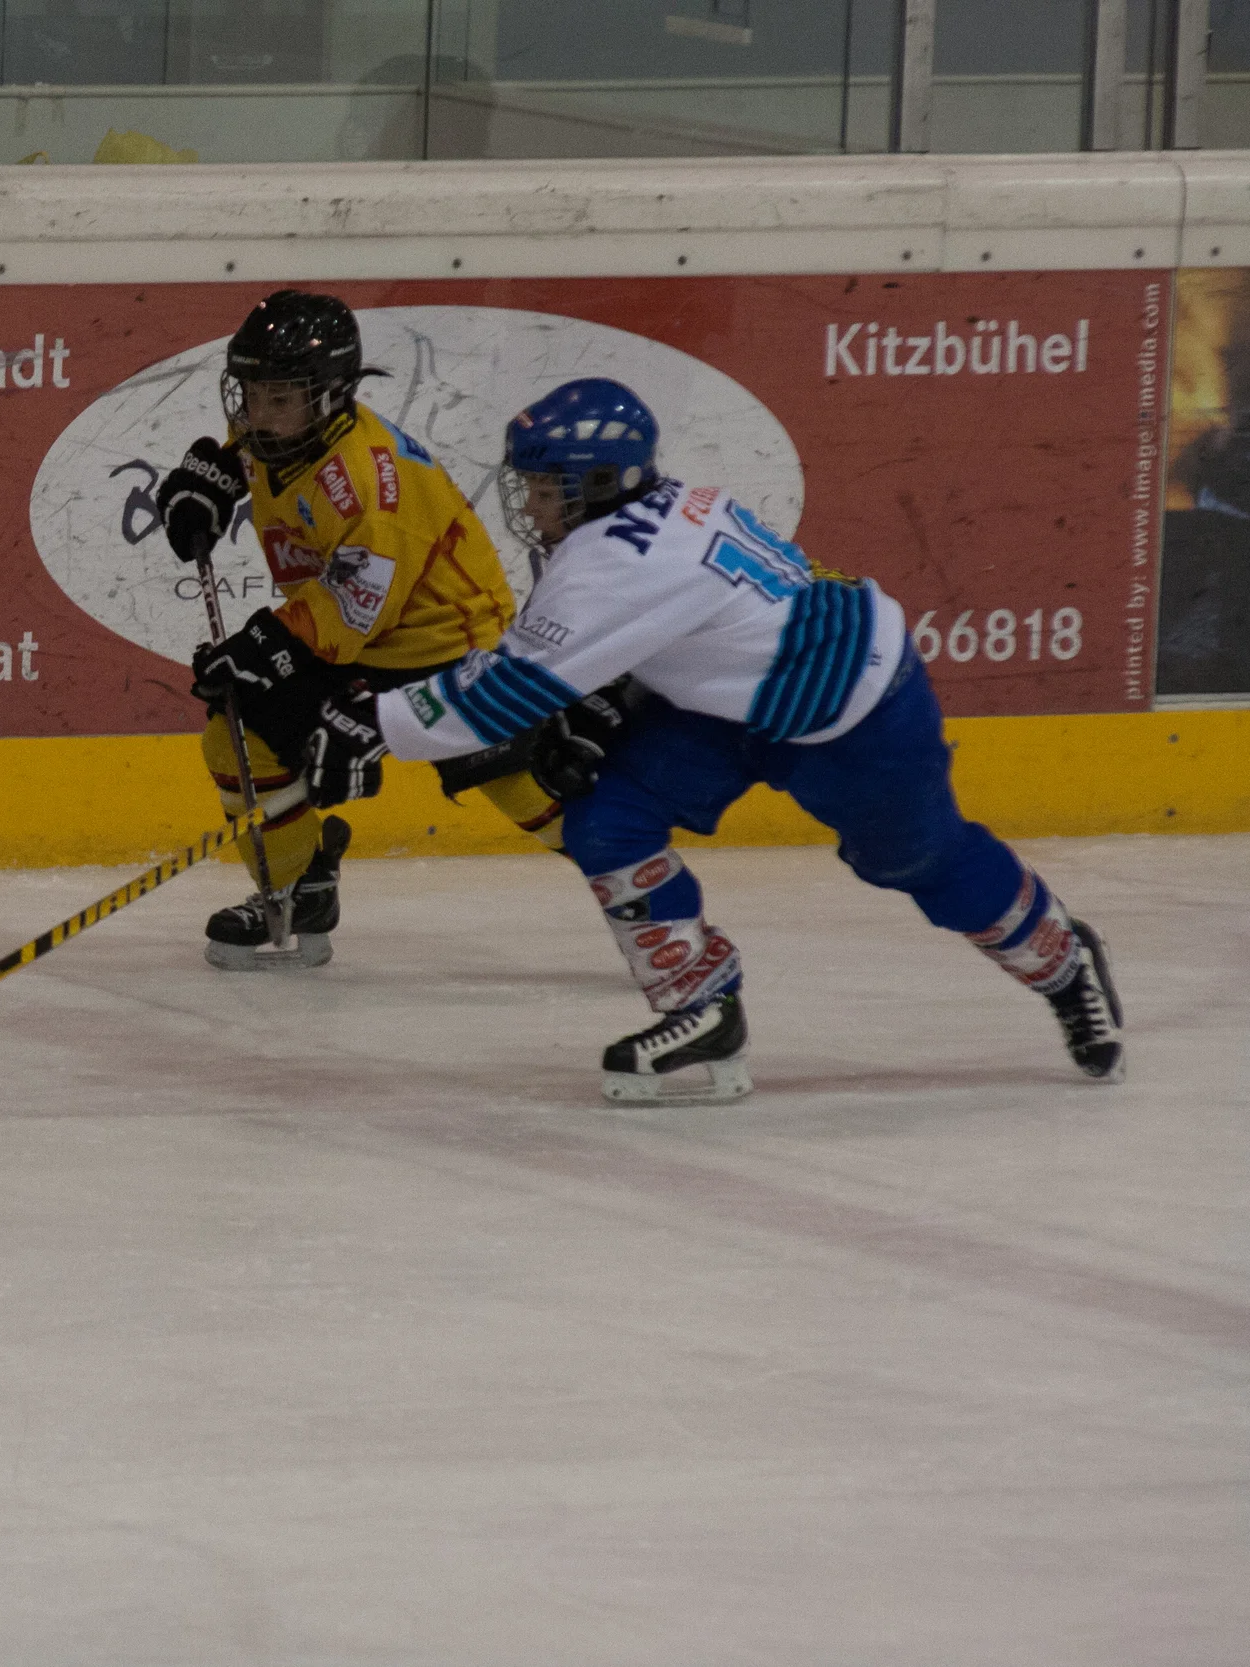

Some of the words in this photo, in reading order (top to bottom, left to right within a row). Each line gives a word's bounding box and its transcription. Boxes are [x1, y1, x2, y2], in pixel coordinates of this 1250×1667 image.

[825, 319, 1090, 377] Kitzbühel
[182, 452, 243, 500] Reebok
[913, 606, 1084, 663] 66818
[1125, 617, 1146, 701] printed
[319, 699, 377, 745] UER
